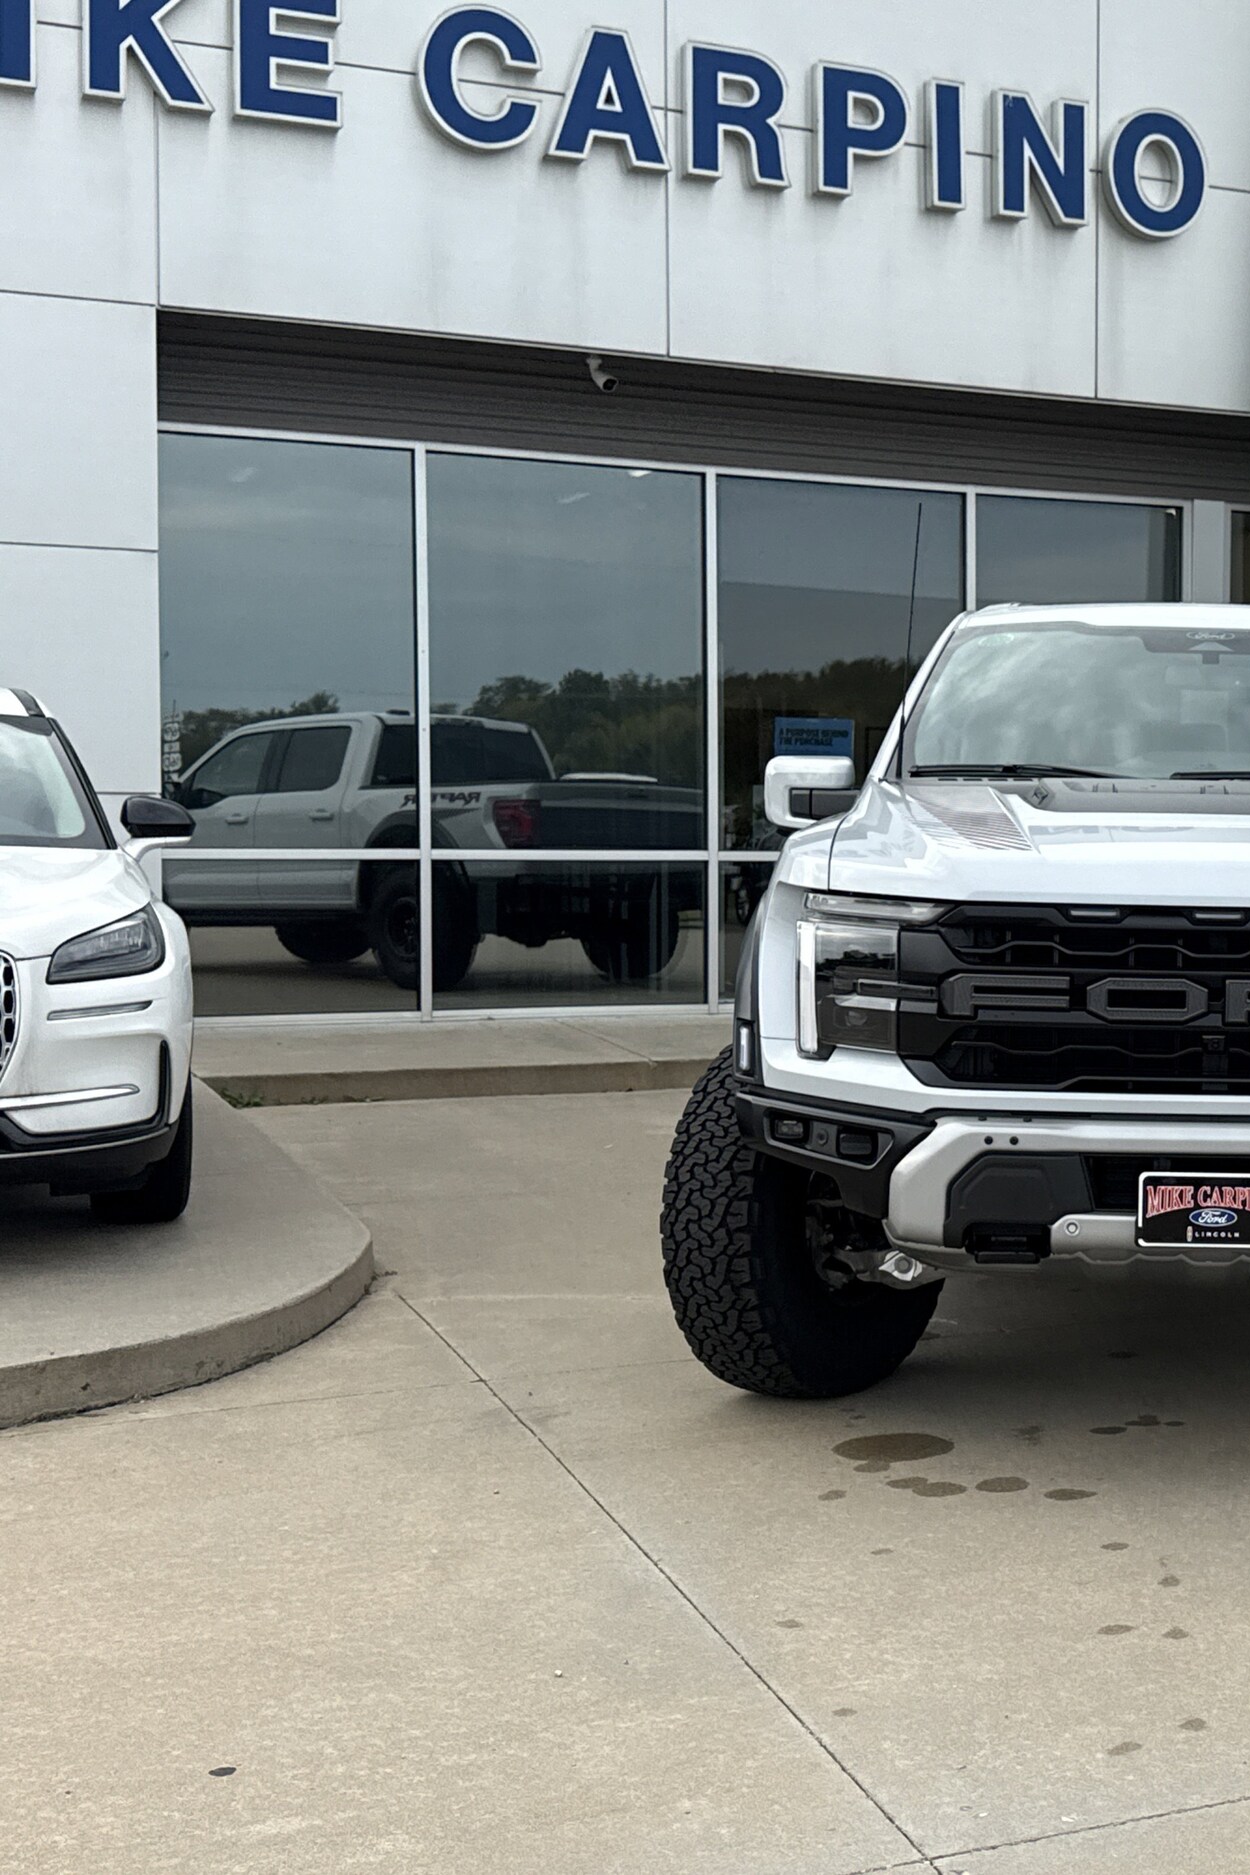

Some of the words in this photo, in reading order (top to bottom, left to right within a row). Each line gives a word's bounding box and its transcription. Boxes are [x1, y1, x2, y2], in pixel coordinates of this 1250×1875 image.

[417, 3, 1207, 239] CARPINO
[1146, 1185, 1194, 1218] MIKE
[1198, 1211, 1227, 1224] Ford
